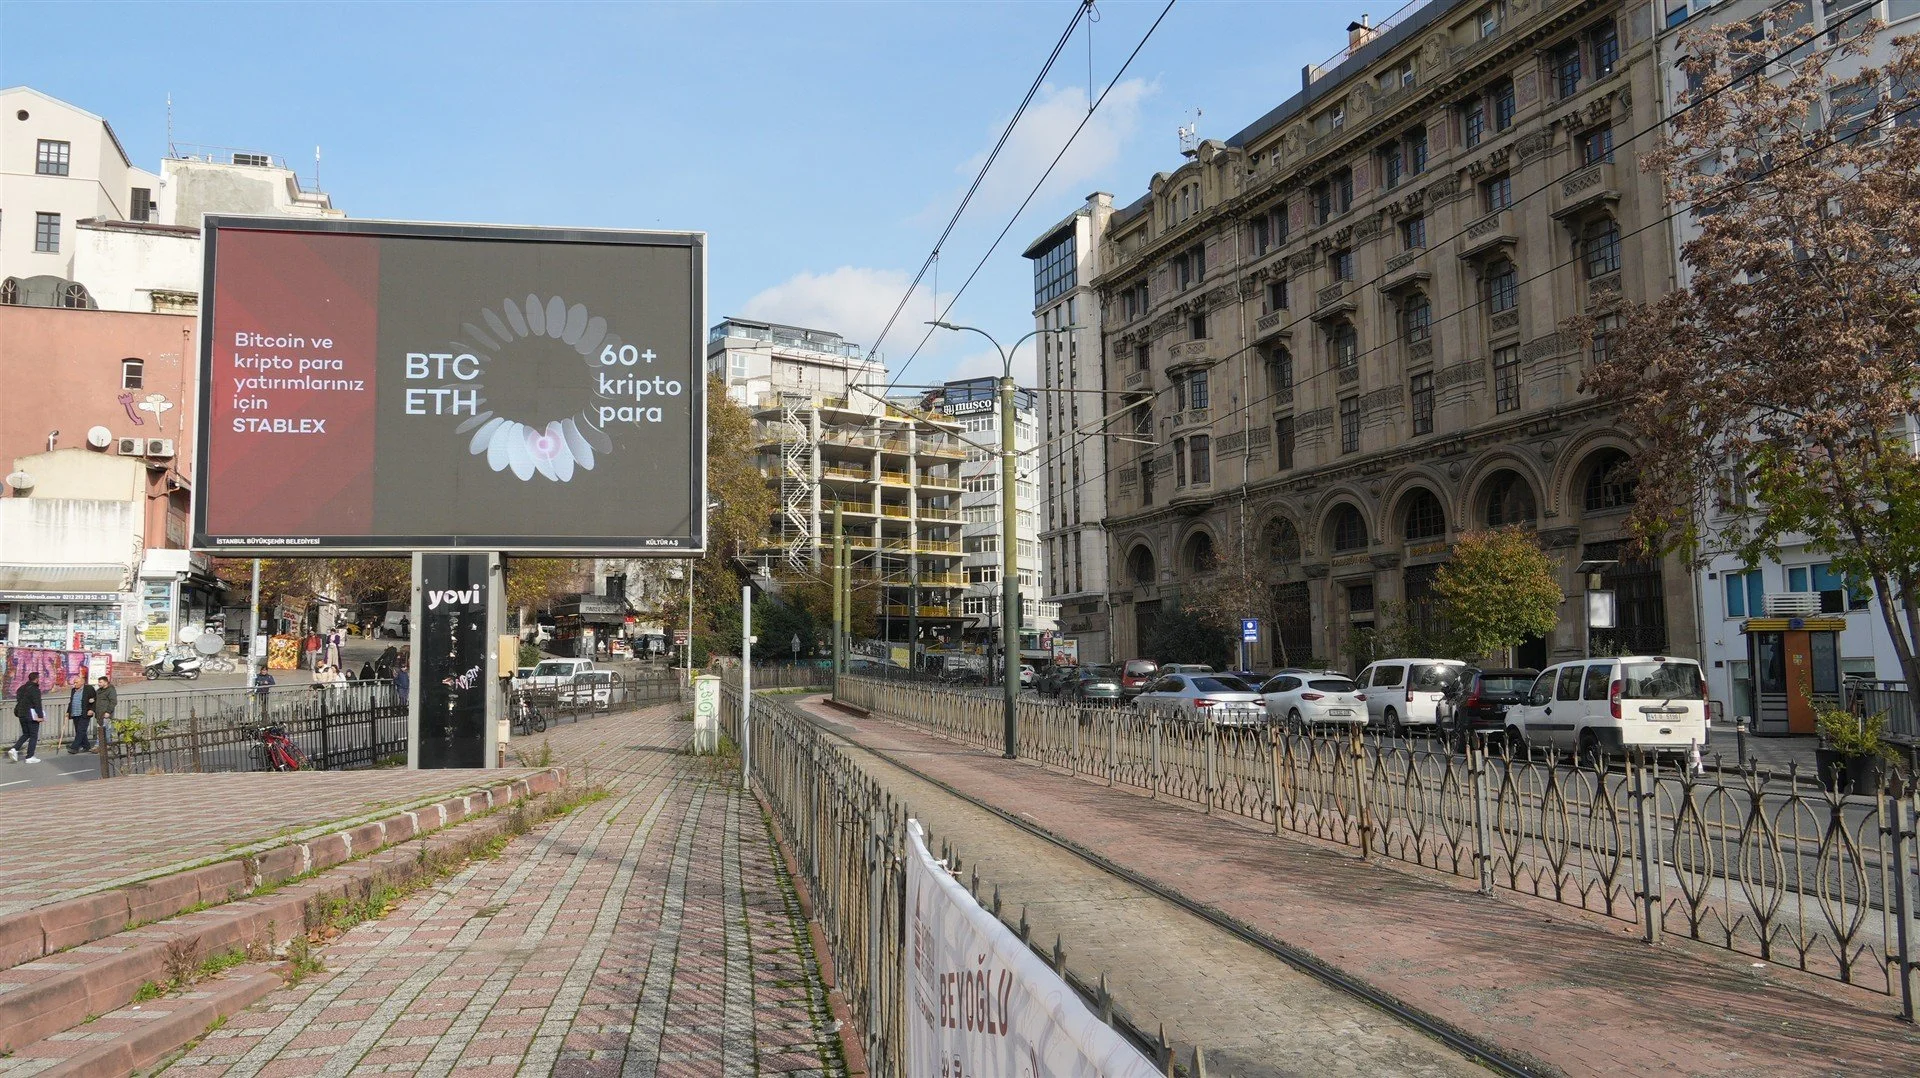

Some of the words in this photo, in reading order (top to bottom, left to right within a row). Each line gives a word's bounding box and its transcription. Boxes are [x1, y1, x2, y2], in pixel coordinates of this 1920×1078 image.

[235, 332, 305, 348] Bitcoin
[311, 338, 333, 348] ve
[234, 353, 293, 373] kripto
[299, 359, 343, 374] para
[600, 344, 657, 366] 60+
[406, 353, 480, 380] BTC
[233, 375, 364, 392] yatırımlarınız
[600, 372, 682, 402] kripto
[233, 394, 268, 413] için
[405, 388, 477, 416] ETH
[955, 400, 992, 411] musco
[232, 418, 326, 433] STABLEX
[600, 406, 662, 428] para
[216, 537, 246, 545] İSTANBUL
[246, 537, 285, 546] BÜYÜKŞEHİR
[286, 537, 320, 545] BELEDİYESİ
[645, 538, 669, 546] KÜLTÜR
[428, 583, 480, 610] yovi
[940, 953, 1013, 1037] BEYOĞLU
